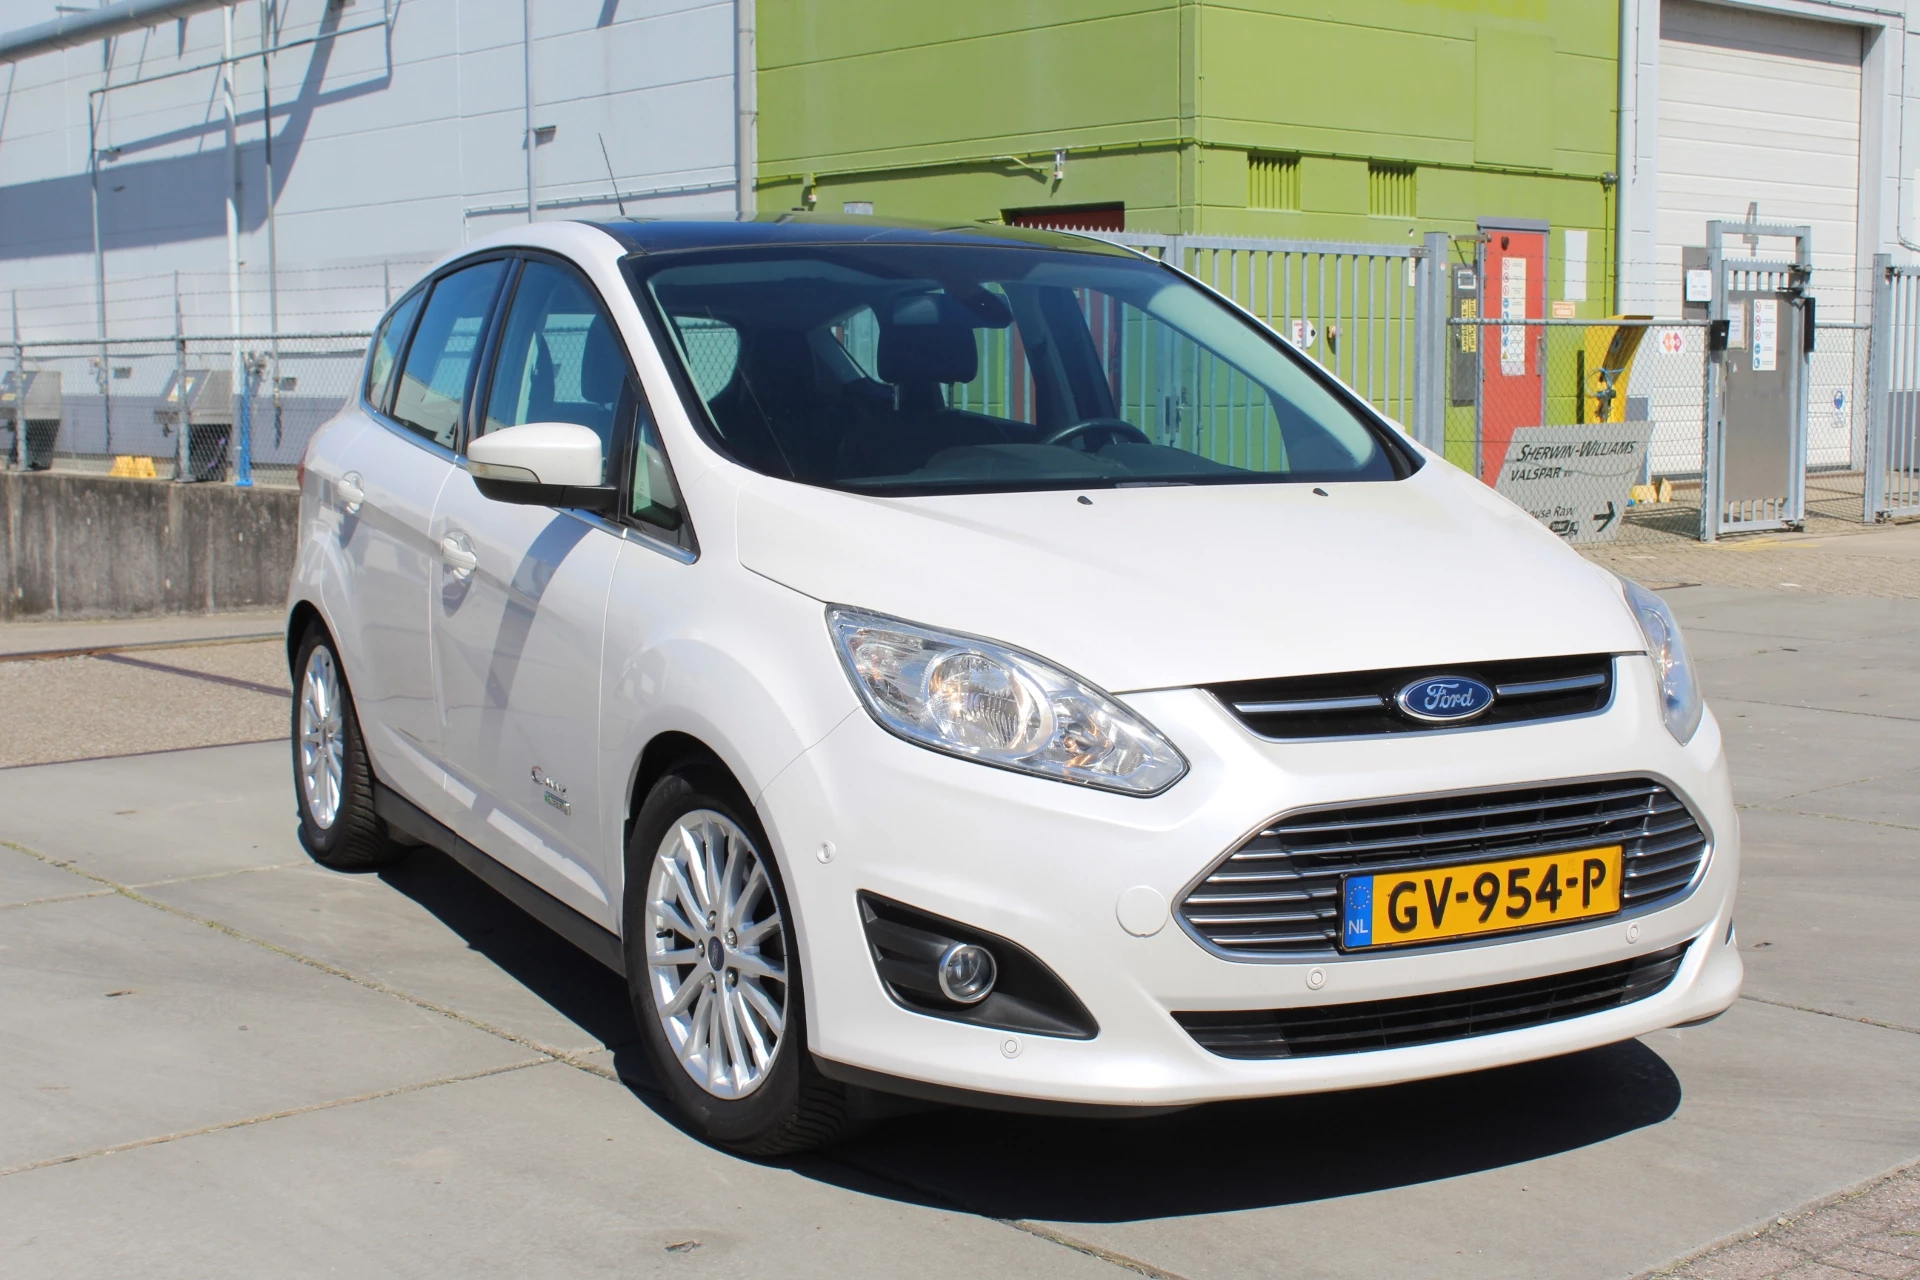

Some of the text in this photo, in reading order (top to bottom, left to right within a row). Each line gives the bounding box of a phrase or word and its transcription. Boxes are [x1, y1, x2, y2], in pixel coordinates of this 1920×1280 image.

[1516, 440, 1637, 462] SHERWIN-WILLIAMS
[1511, 467, 1562, 482] VALSPAR
[1553, 505, 1576, 517] Raw
[1424, 683, 1475, 710] Ford
[1387, 858, 1606, 933] GV-954-P
[1348, 919, 1368, 934] NL
